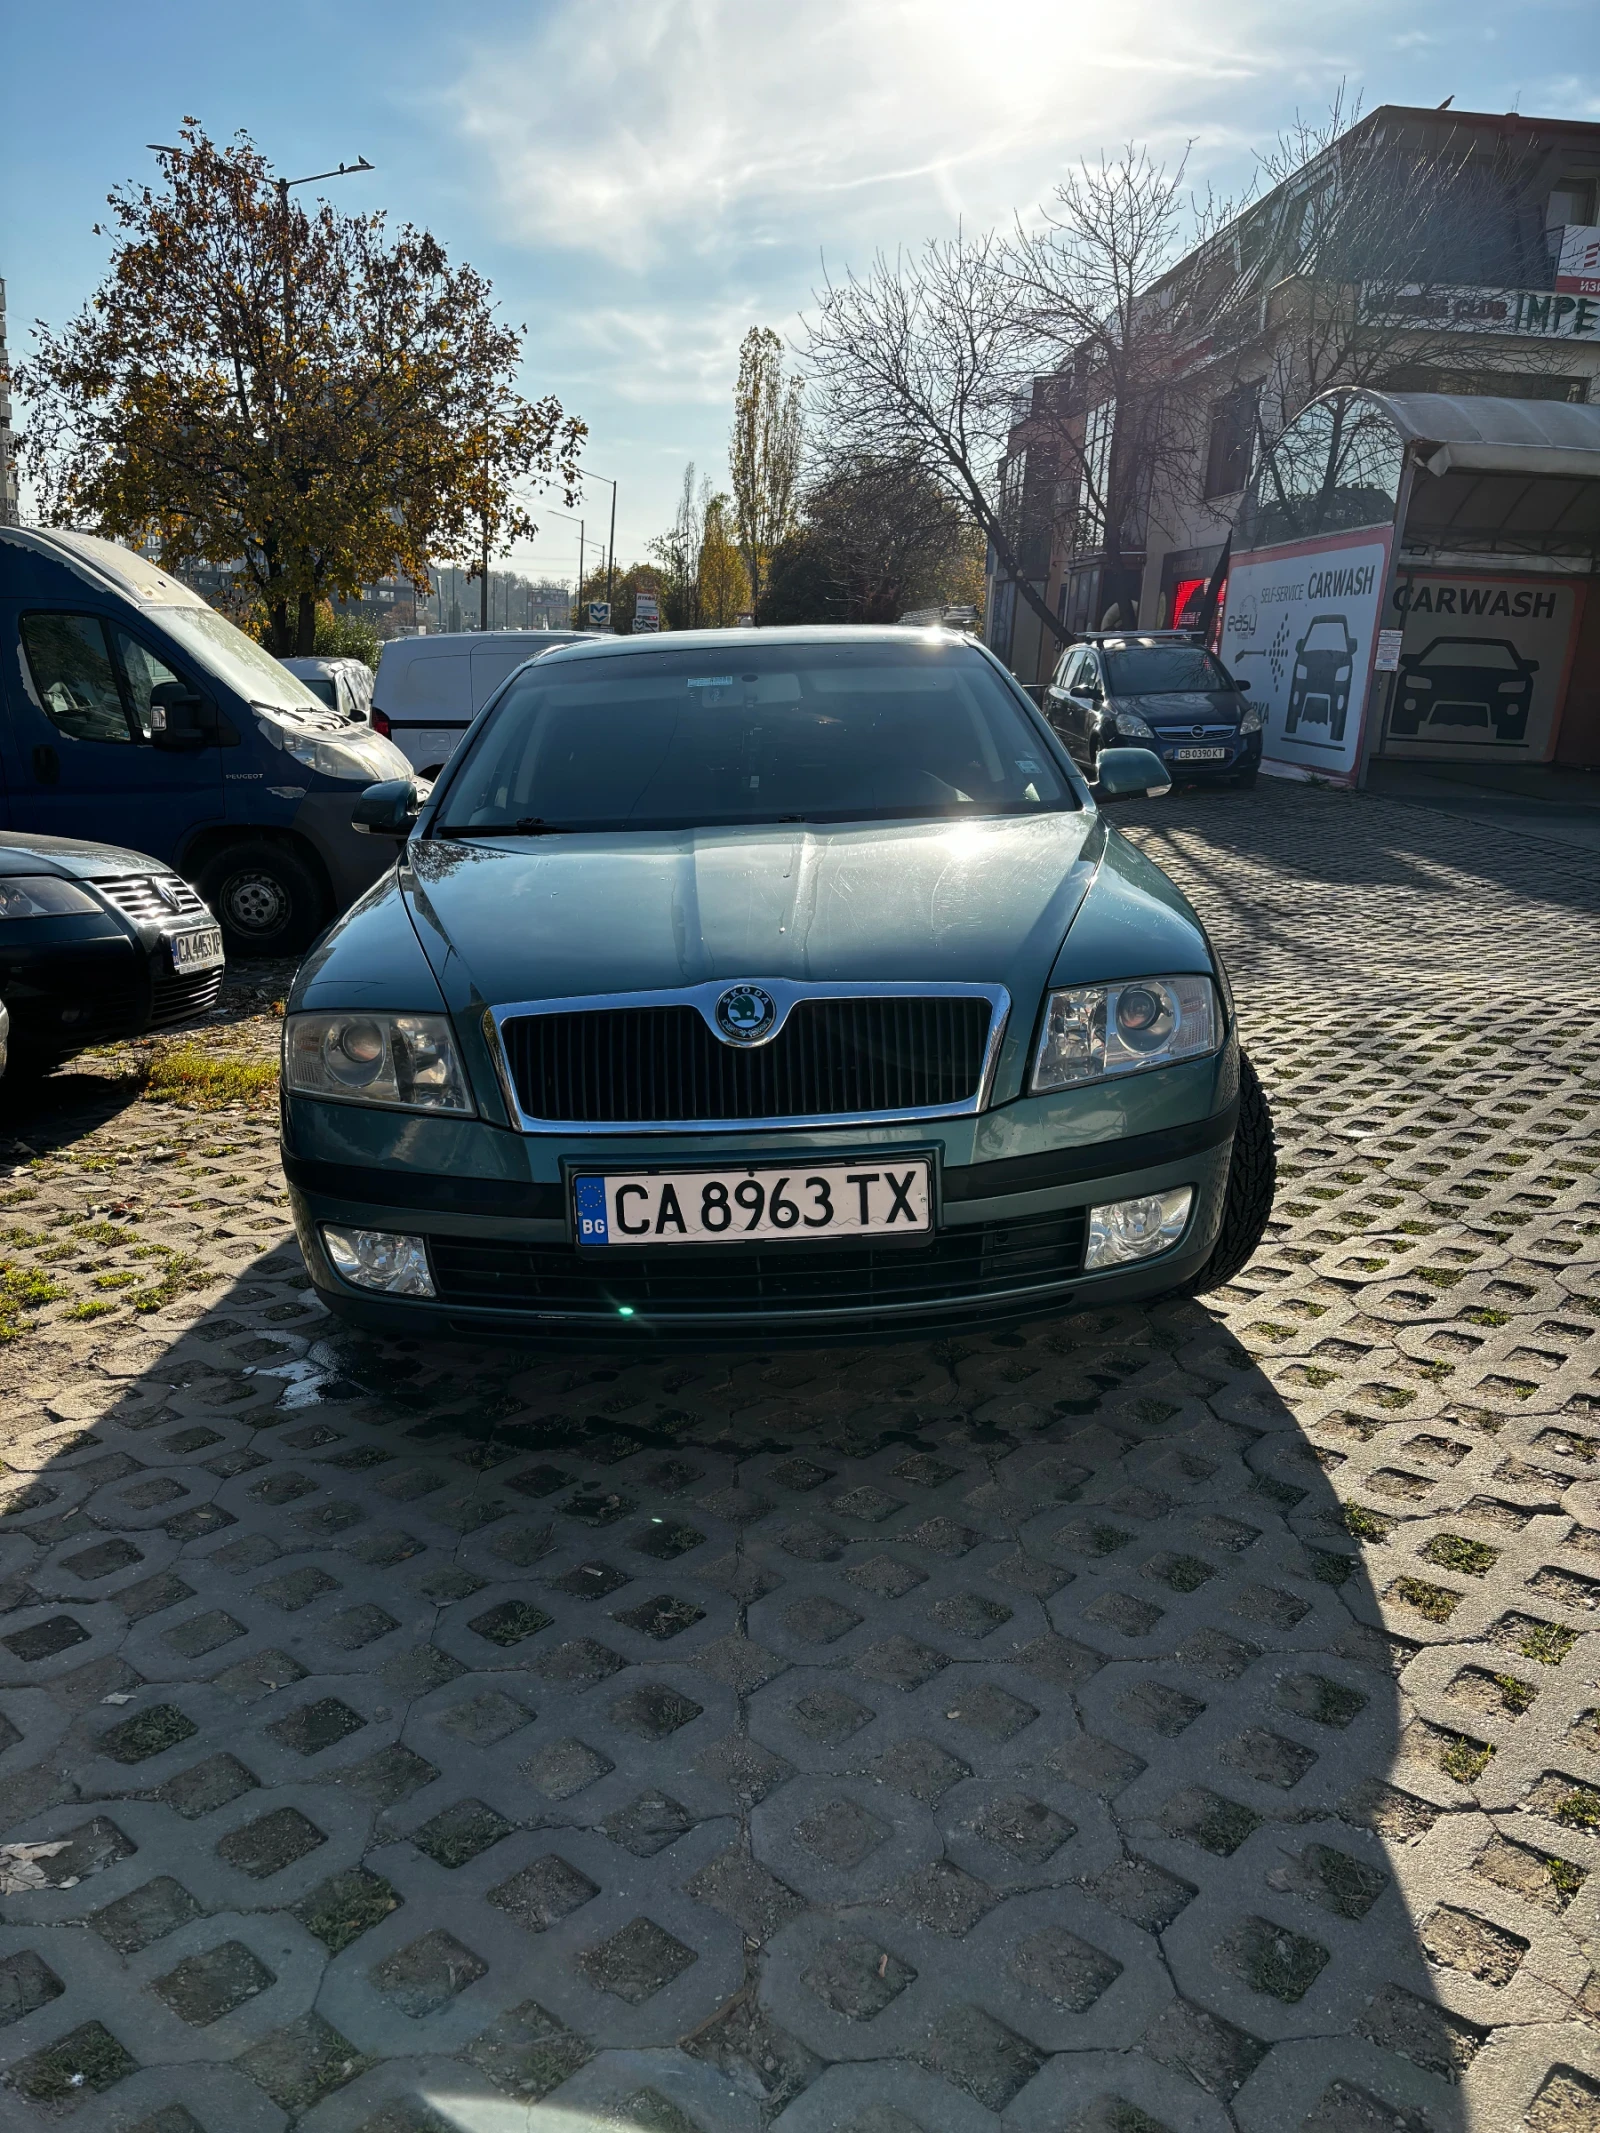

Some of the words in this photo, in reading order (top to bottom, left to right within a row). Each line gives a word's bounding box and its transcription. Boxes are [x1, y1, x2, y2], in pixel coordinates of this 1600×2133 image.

[1261, 584, 1304, 604] SELF-SERVICE
[1308, 565, 1376, 600] CARWASH
[1392, 585, 1557, 619] CARWASH
[1227, 614, 1258, 636] easy
[1192, 749, 1212, 758] 0390
[1212, 748, 1224, 758] KT
[582, 1219, 605, 1235] BG
[615, 1182, 688, 1236] CA
[700, 1176, 835, 1233] 8963
[846, 1170, 918, 1226] TX
